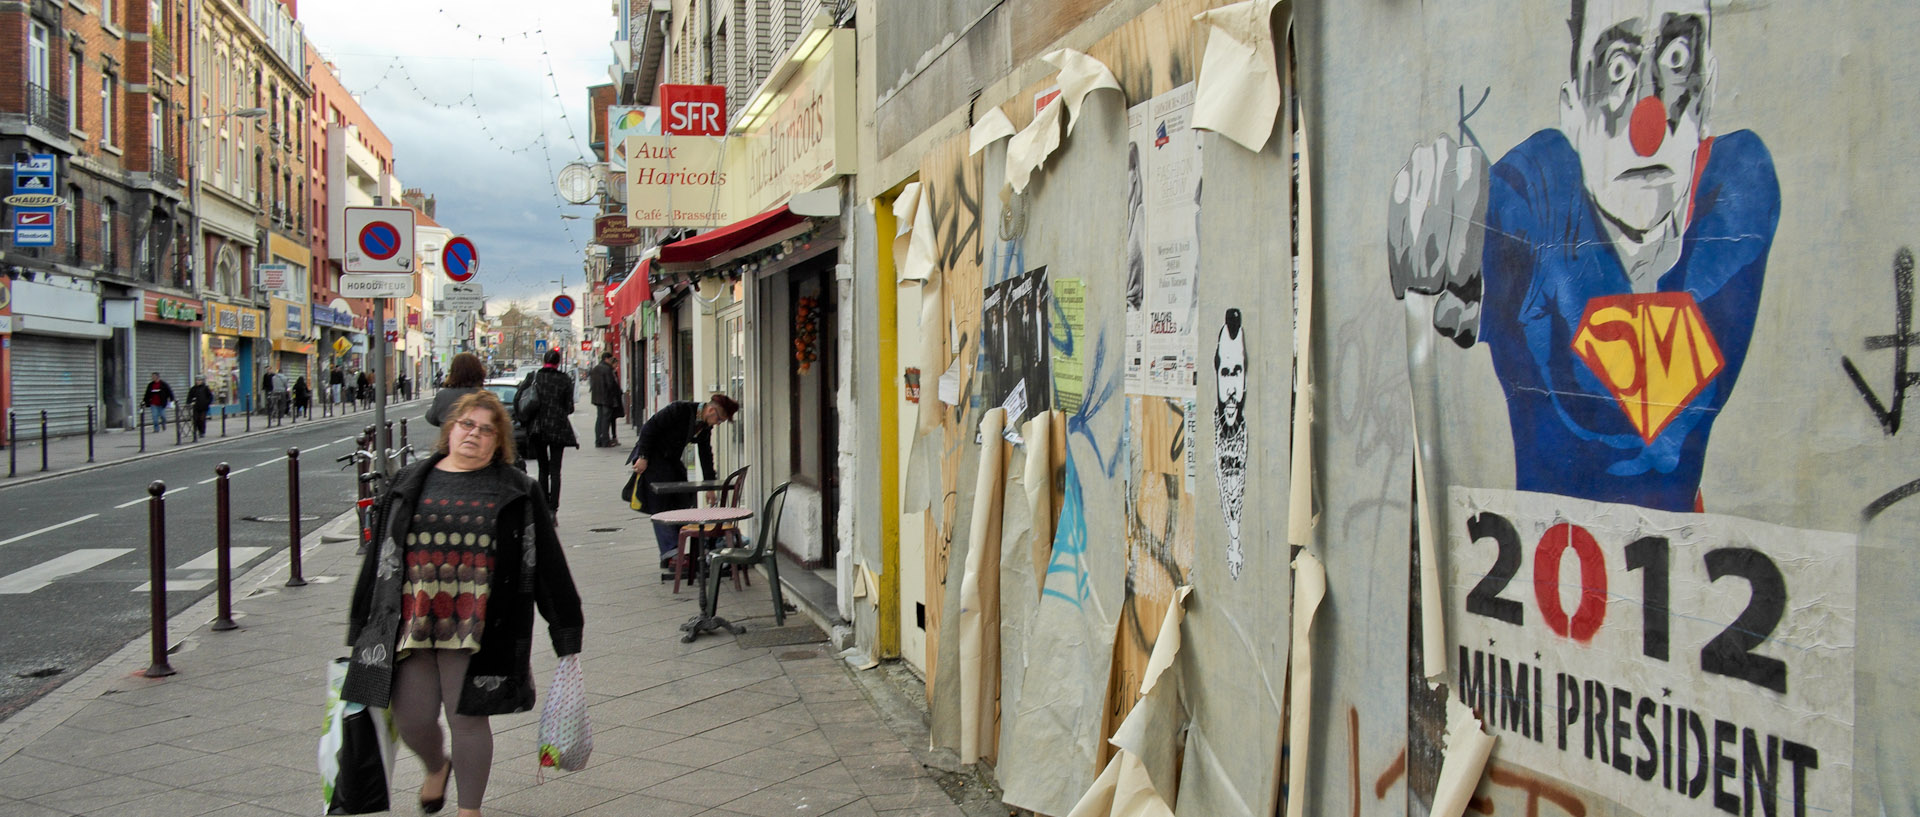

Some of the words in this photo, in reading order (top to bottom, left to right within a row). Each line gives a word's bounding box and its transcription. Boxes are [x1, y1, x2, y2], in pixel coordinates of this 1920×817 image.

[670, 101, 720, 131] SFR
[769, 89, 824, 182] Haricots
[635, 142, 677, 160] Aux
[637, 167, 727, 186] Haricots
[9, 195, 59, 204] CHAUSSEA
[635, 209, 661, 221] Café
[672, 209, 727, 221] Brasserie
[347, 282, 406, 290] HORODATEUR
[1465, 511, 1789, 695] 2012
[1458, 637, 1544, 743] MIMI
[1556, 671, 1820, 817] PRESIDENT
